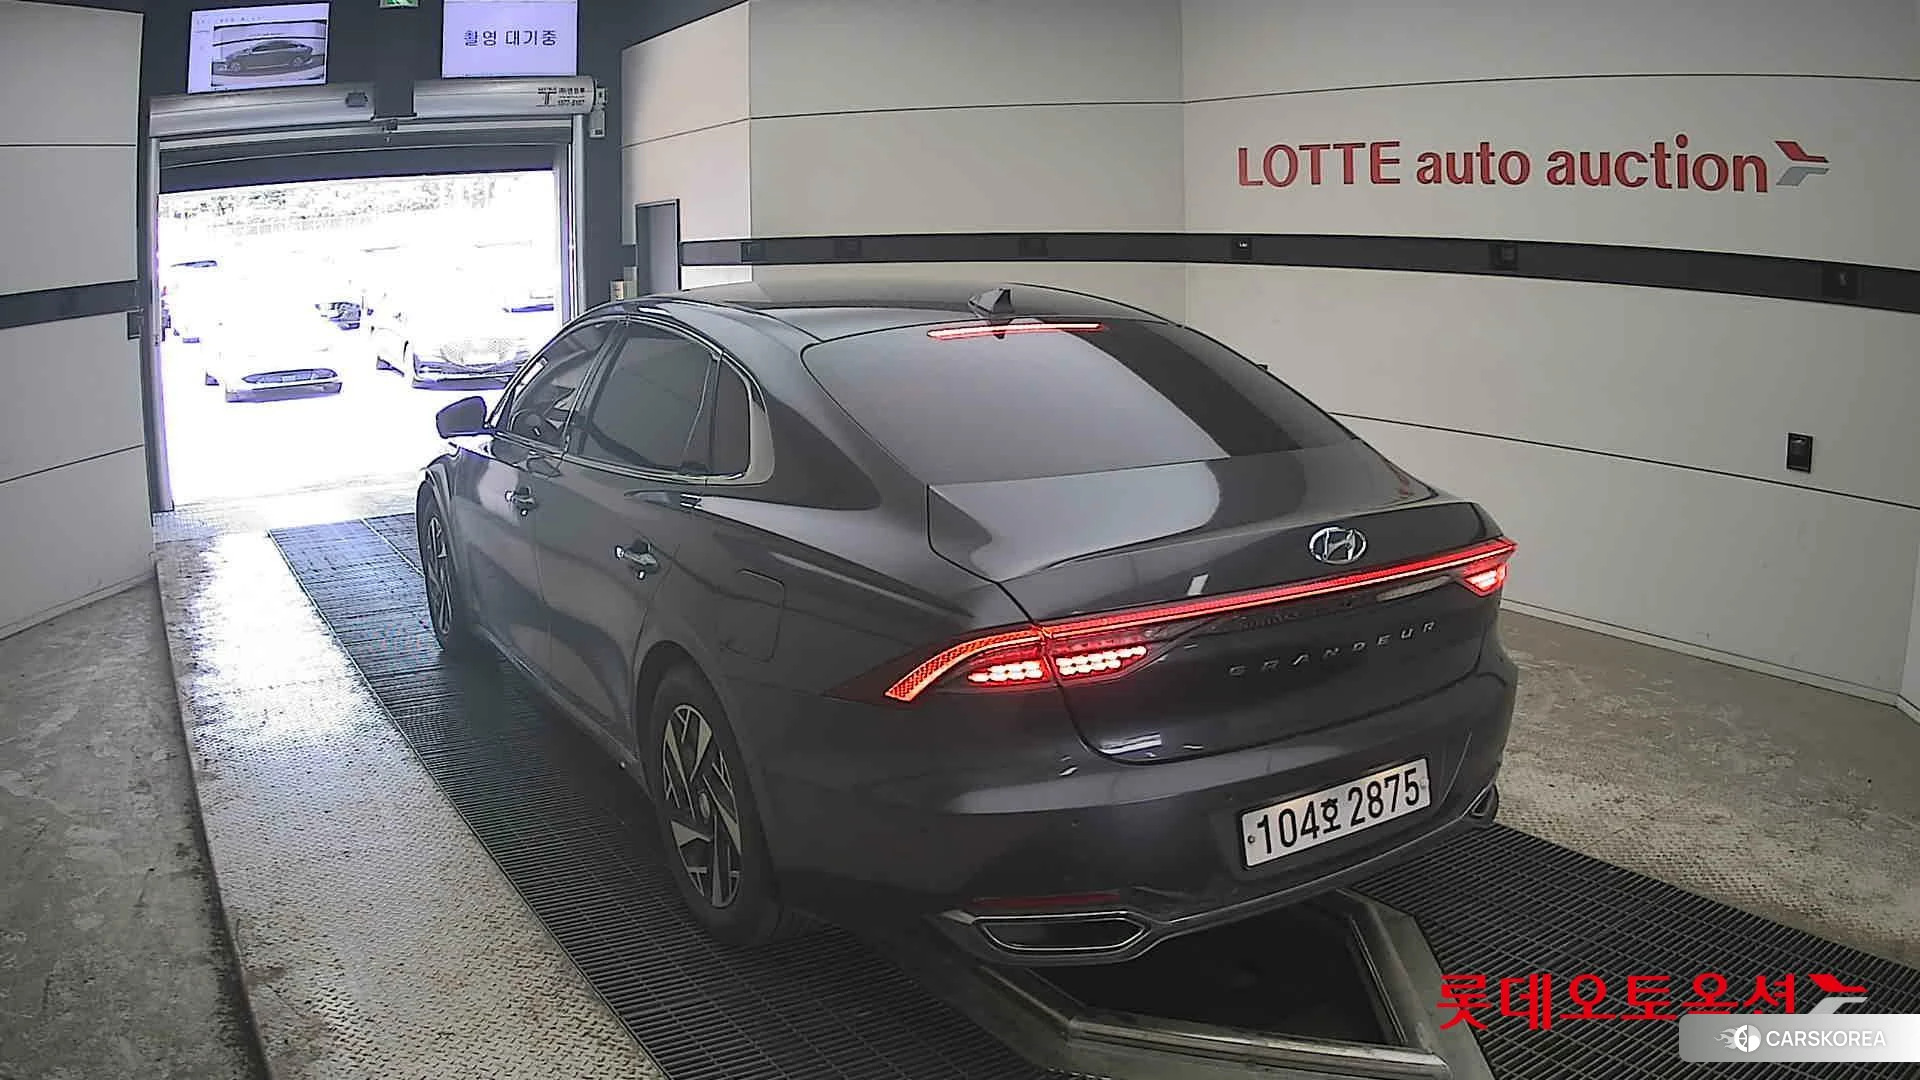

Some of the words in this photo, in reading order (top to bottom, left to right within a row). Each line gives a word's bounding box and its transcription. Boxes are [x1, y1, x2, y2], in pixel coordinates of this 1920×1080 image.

[505, 30, 556, 46] 대기중
[1238, 141, 1401, 187] LOTTE
[1416, 142, 1531, 185] auto
[1546, 134, 1768, 193] auction
[1228, 620, 1436, 677] GRANDEUR
[1348, 768, 1421, 827] 2875
